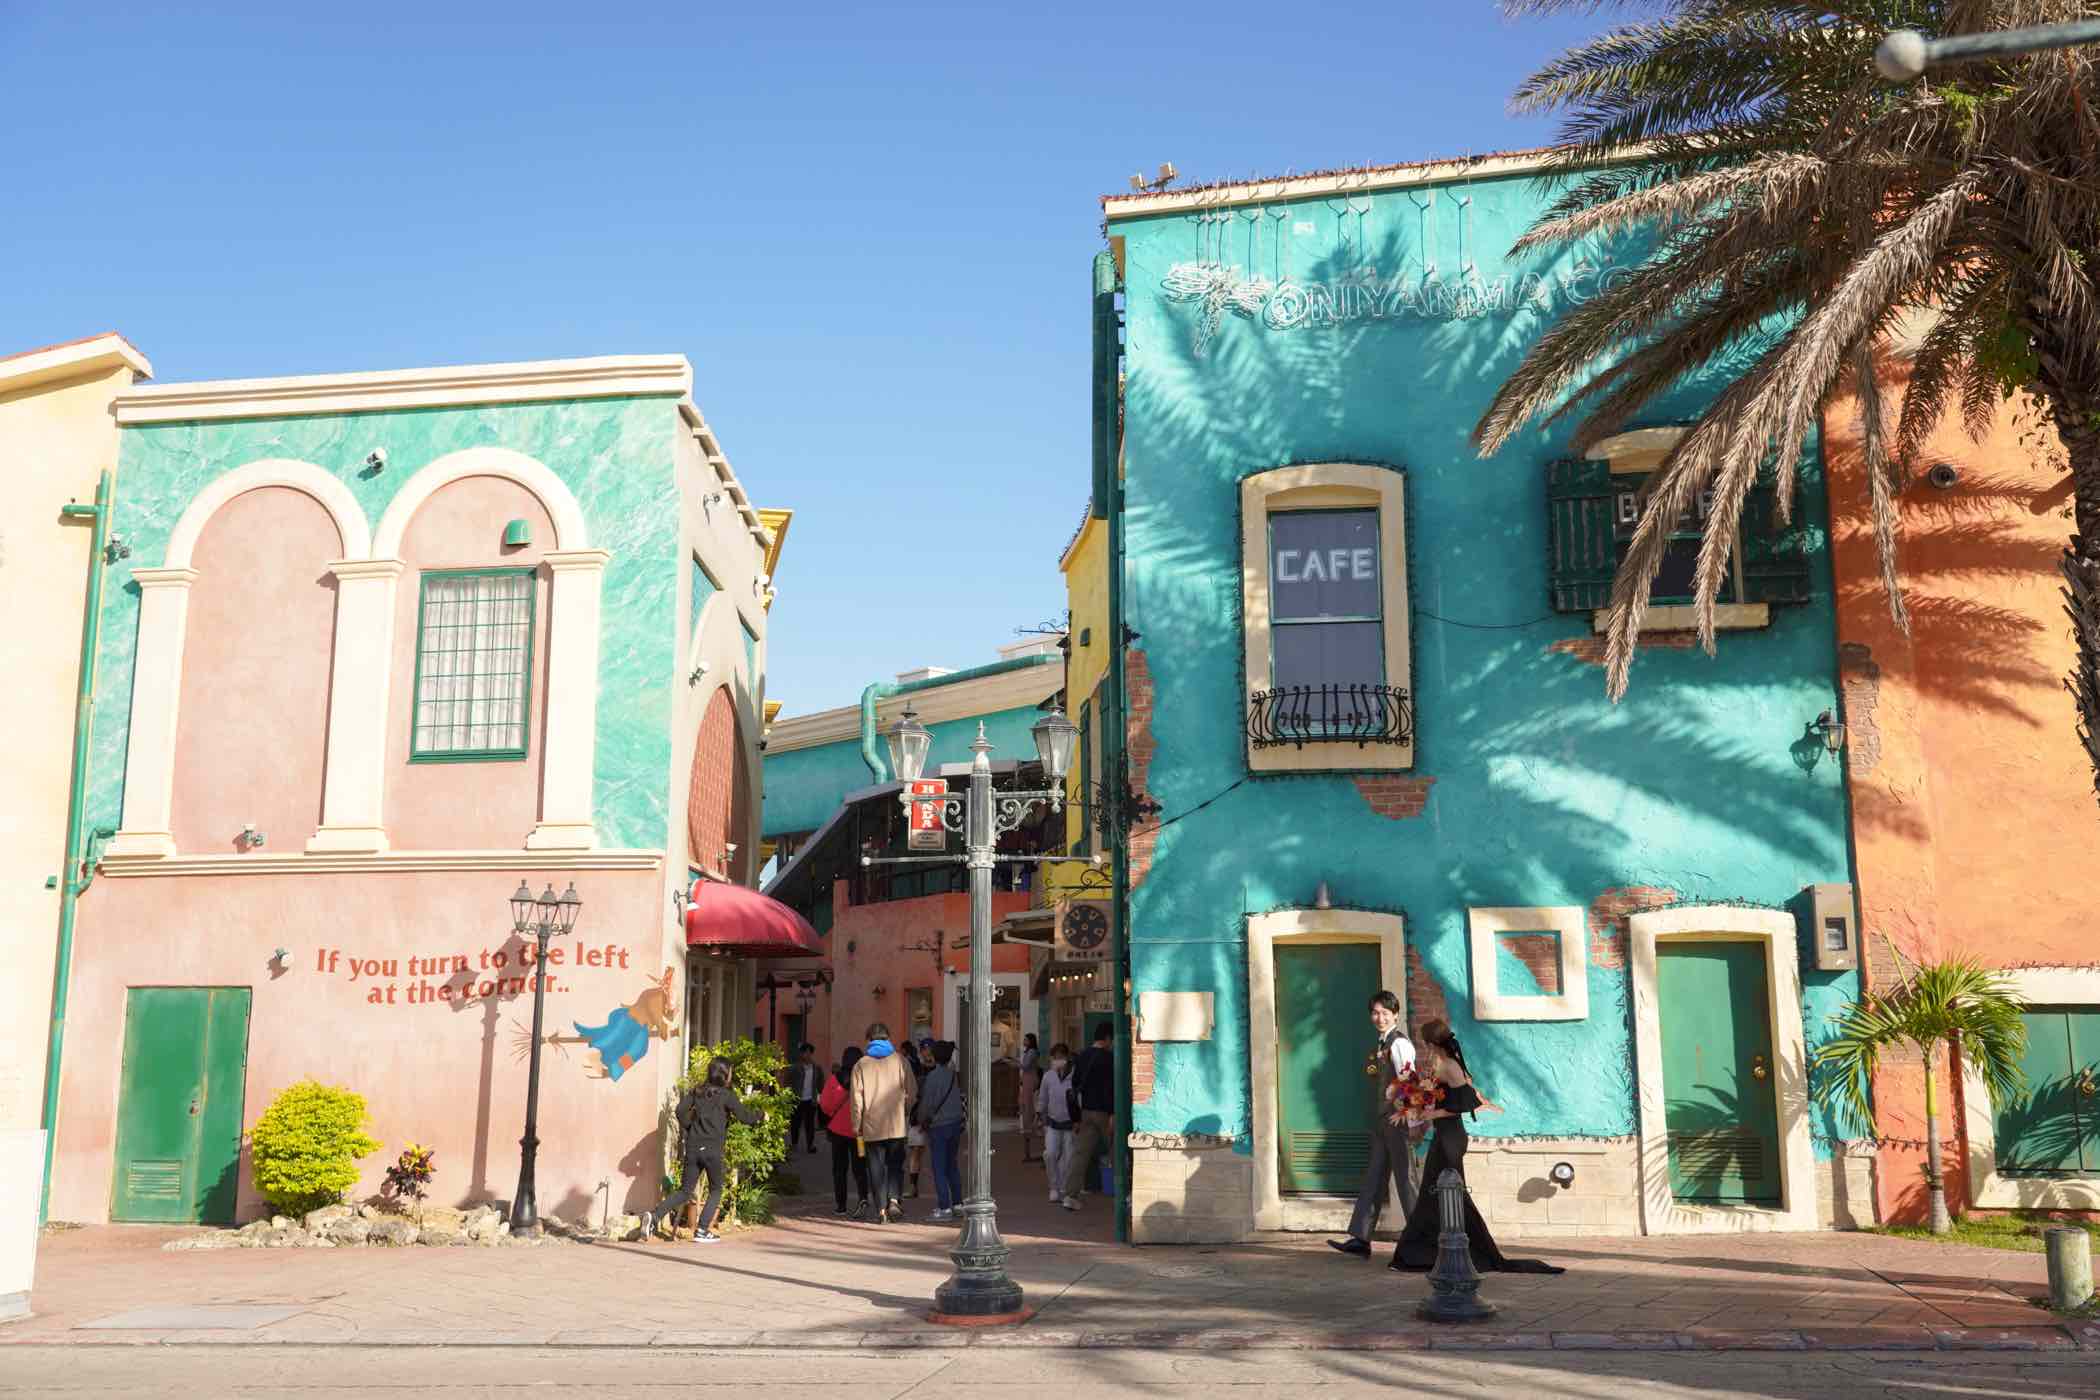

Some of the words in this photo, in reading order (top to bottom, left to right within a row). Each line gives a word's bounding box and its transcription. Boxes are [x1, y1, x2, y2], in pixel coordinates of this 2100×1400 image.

[1268, 272, 1548, 325] ONIYANMA
[1277, 548, 1374, 582] CAFE
[922, 784, 935, 829] HNDA
[316, 948, 340, 973] If
[348, 957, 398, 981] you
[407, 953, 469, 977] turn
[479, 947, 508, 970] to
[575, 942, 630, 969] left
[367, 982, 397, 1005] at
[406, 980, 452, 1005] the
